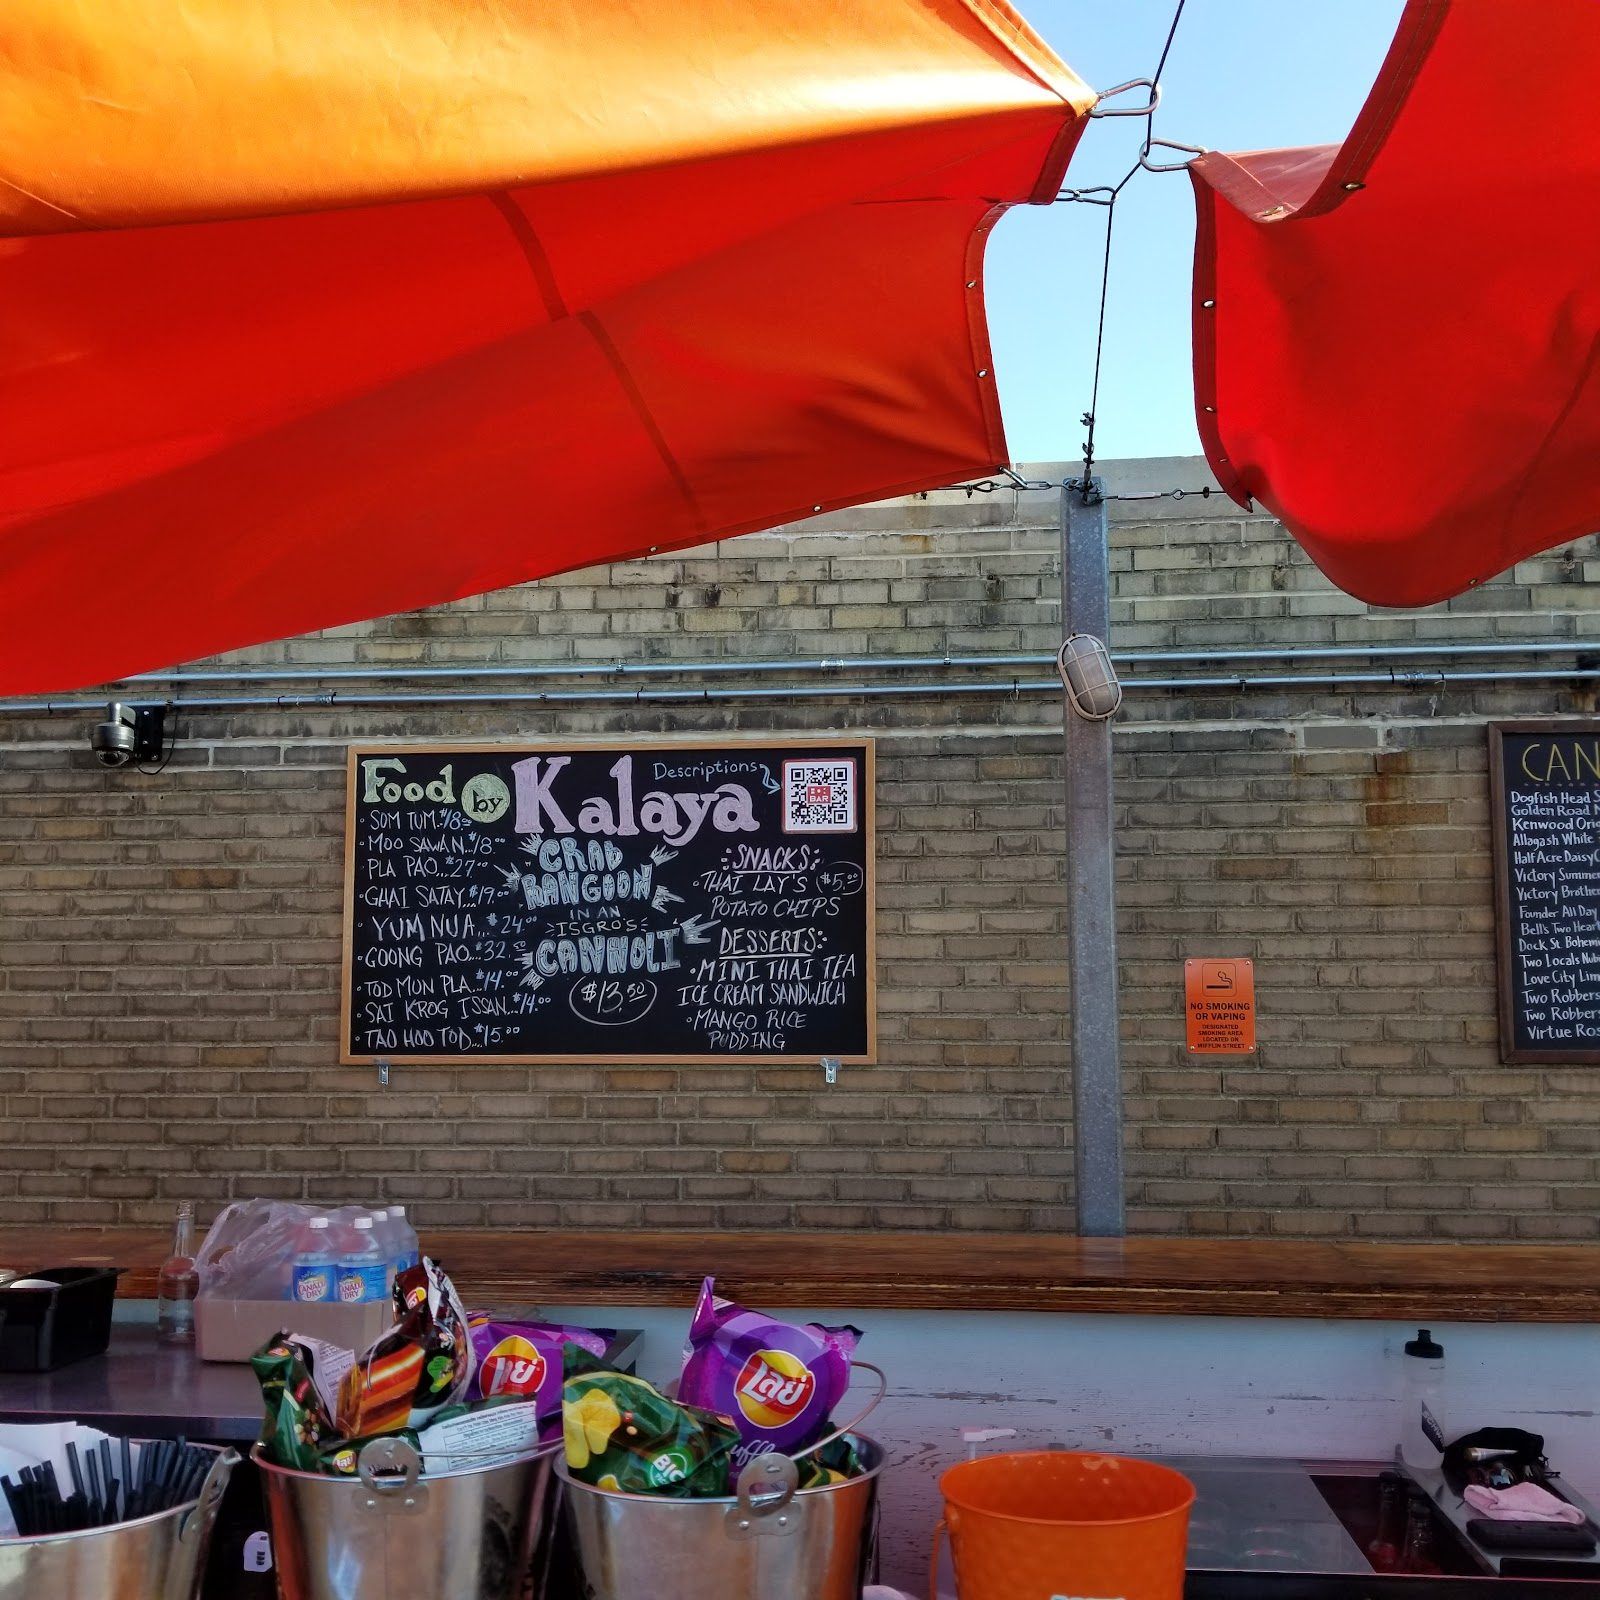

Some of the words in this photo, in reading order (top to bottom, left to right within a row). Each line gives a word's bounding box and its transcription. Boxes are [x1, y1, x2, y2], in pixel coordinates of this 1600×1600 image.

[653, 760, 757, 782] Descriptions
[361, 758, 456, 803] Food
[472, 789, 503, 814] by
[511, 755, 760, 847] Kalaya
[1511, 791, 1558, 806] Dogfish
[1561, 792, 1591, 804] Head
[1511, 804, 1555, 816] Golden
[1557, 805, 1591, 816] Road
[370, 810, 400, 830] SOM
[1512, 818, 1573, 831] Kenwood
[368, 833, 403, 853] MOO
[1513, 834, 1559, 851] Allagash
[1561, 832, 1594, 845] White
[1514, 851, 1536, 864] Half
[1537, 851, 1562, 863] Acre
[1564, 850, 1594, 867] Daisy
[367, 858, 396, 879] PLA
[521, 863, 653, 910] RANGOON
[701, 871, 743, 895] THAI
[753, 874, 808, 894] LAY'S
[1515, 868, 1556, 889] Victory
[365, 886, 409, 908] GHAI
[1516, 887, 1558, 905] Victory
[570, 908, 590, 921] IN
[597, 905, 621, 918] AN
[711, 895, 768, 919] POTATO
[773, 896, 841, 918] CHIPS
[1520, 906, 1559, 919] Founder
[1562, 905, 1577, 918] All
[1578, 905, 1598, 920] Day
[372, 913, 425, 942] YUM
[556, 918, 638, 936] ISGRO'S
[1521, 922, 1550, 936] Bell's
[1551, 922, 1571, 934] Two
[536, 927, 681, 977] CANNOLI
[1519, 938, 1548, 952] Dock
[365, 946, 423, 968] GOONG
[1519, 954, 1542, 968] Two
[1545, 953, 1580, 967] Locals
[697, 958, 761, 982] MINI
[767, 958, 813, 981] THAI
[822, 954, 856, 979] TEA
[1524, 971, 1550, 986] Love
[1552, 970, 1575, 988] City
[364, 981, 392, 998] TOD
[677, 984, 709, 1006] ICE
[713, 983, 764, 1005] CREAM
[769, 981, 846, 1006] SANDWICH
[1521, 990, 1548, 1004] Two
[365, 1001, 394, 1024] SAI
[405, 999, 449, 1021] KROG
[1190, 1002, 1203, 1010] NO
[1206, 1002, 1250, 1010] SMOKING
[1523, 1009, 1546, 1021] Two
[693, 1009, 757, 1030] MANGO
[766, 1009, 807, 1029] RICE
[364, 1029, 398, 1049] TAO
[403, 1028, 434, 1048] HOO
[708, 1031, 786, 1050] PUDDING
[1527, 1025, 1573, 1039] Virtue
[306, 1289, 321, 1299] DRY
[344, 1289, 359, 1300] DRY
